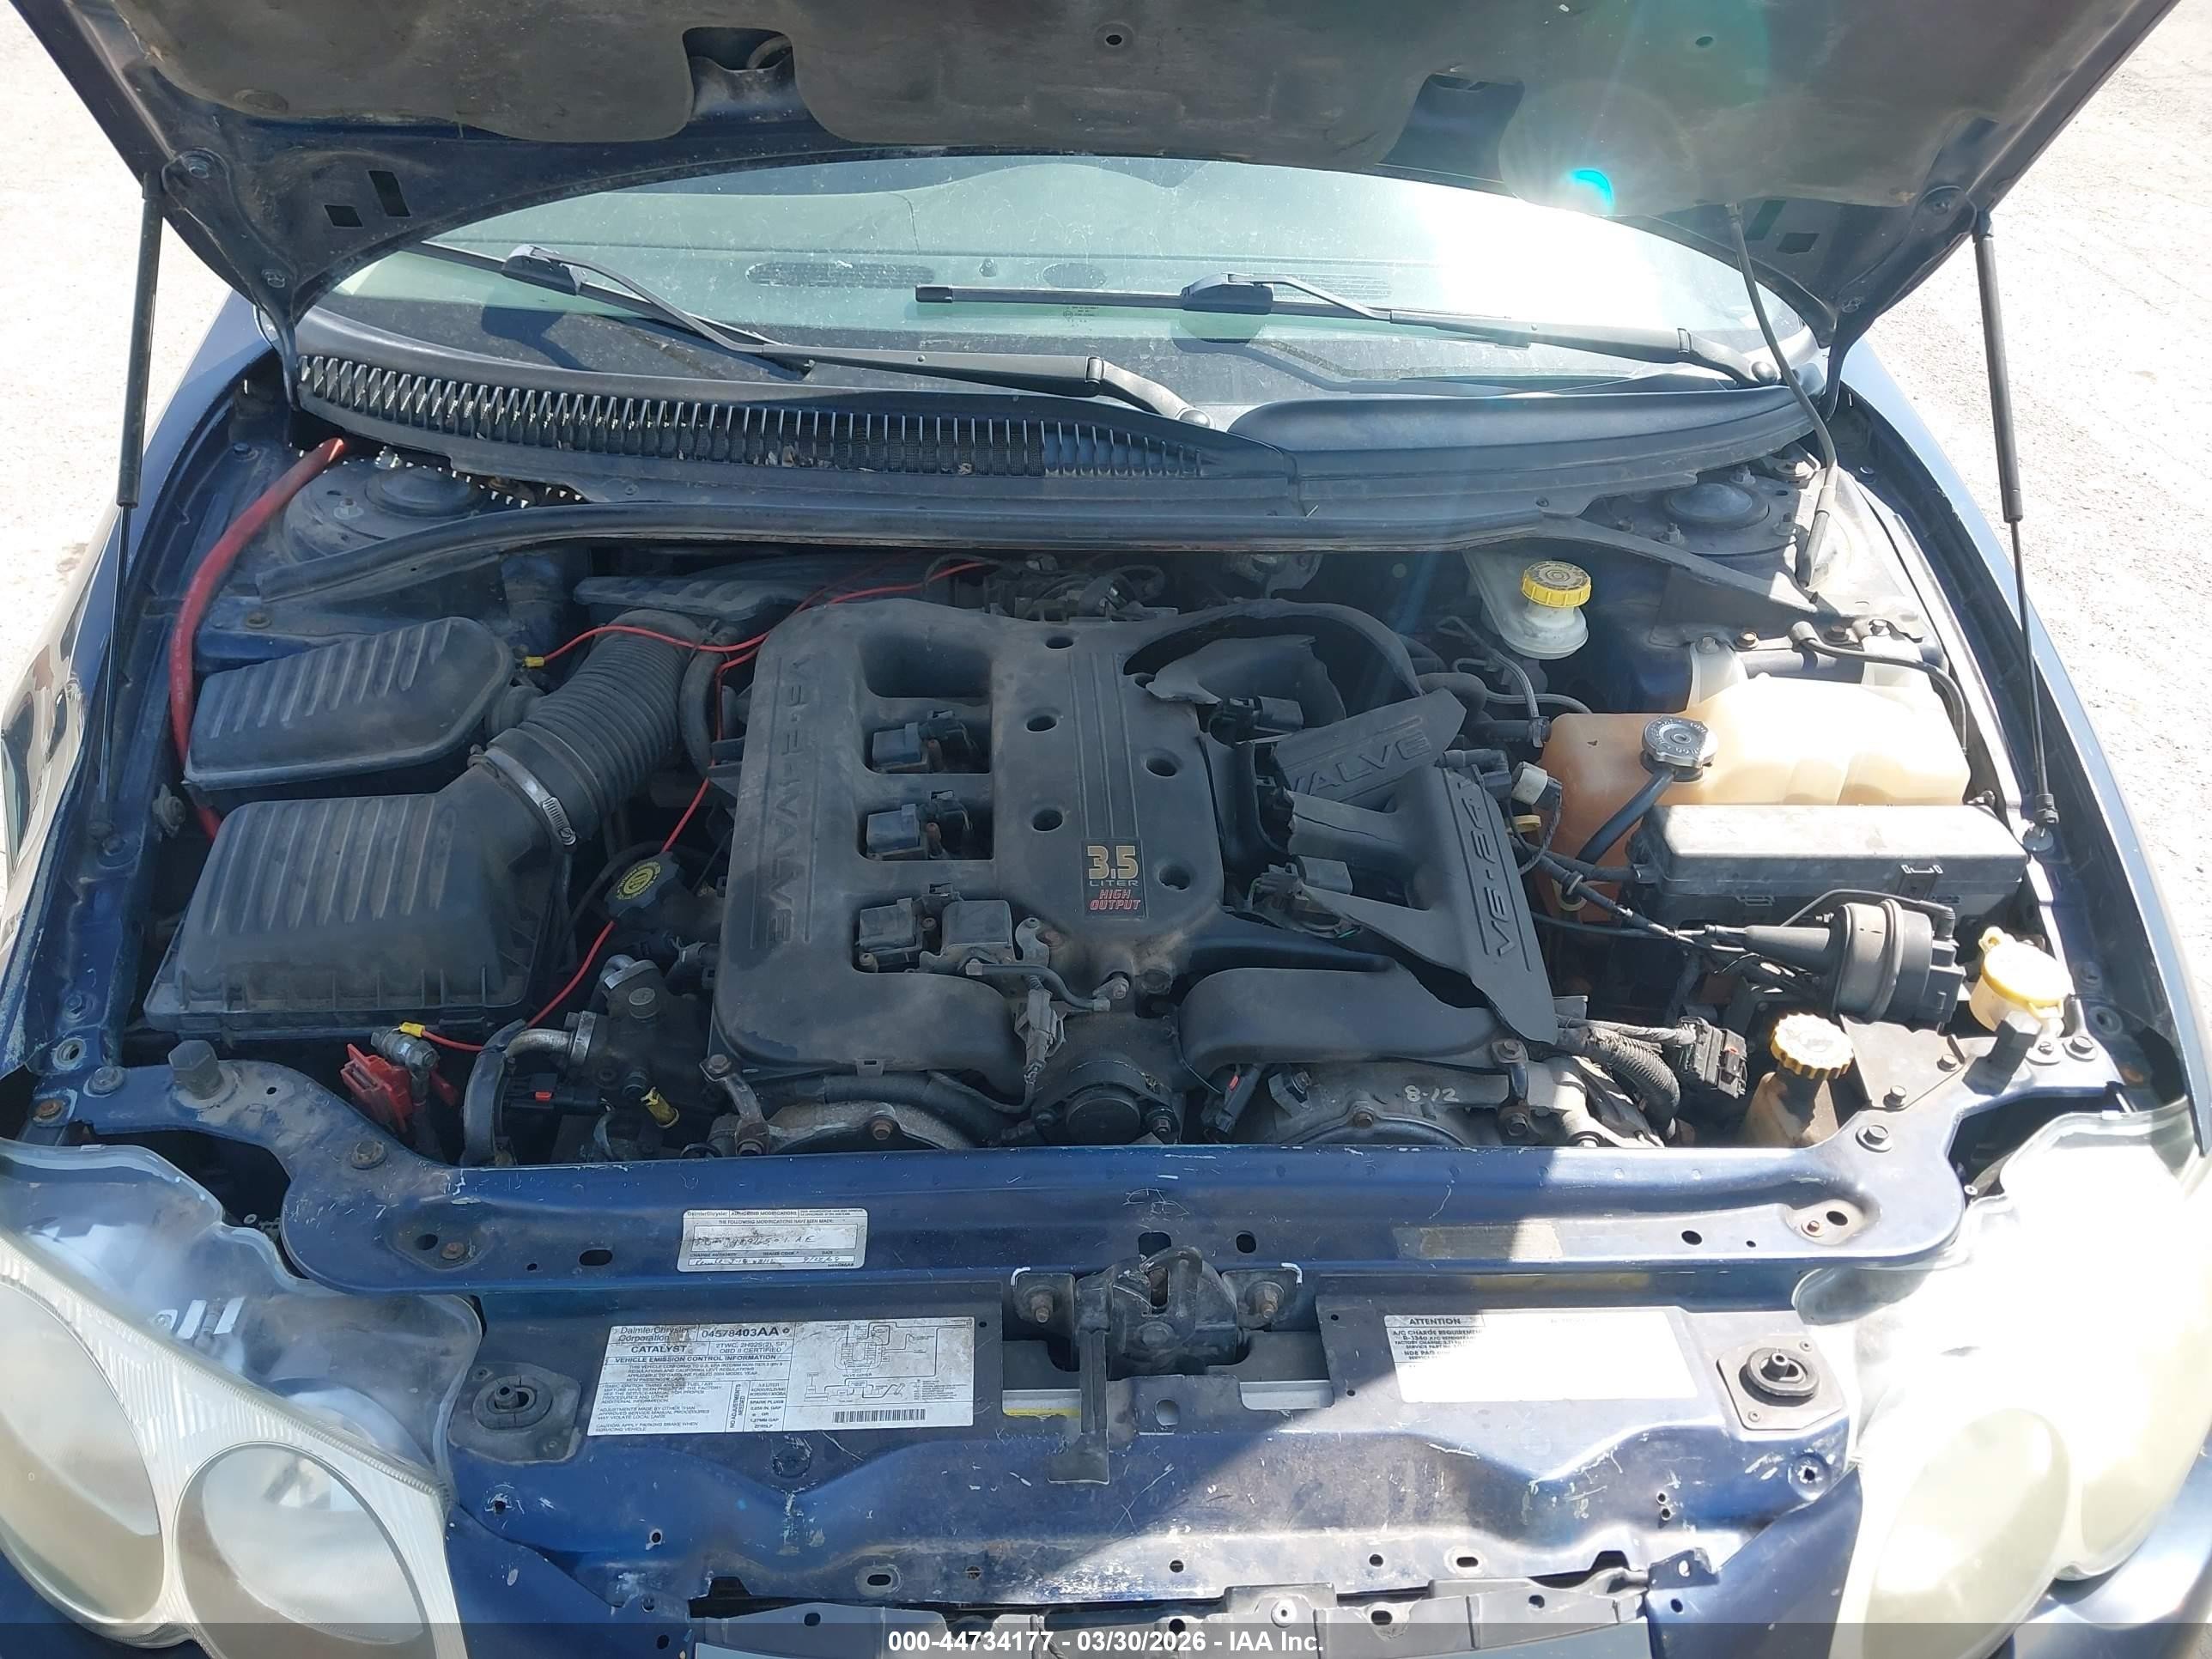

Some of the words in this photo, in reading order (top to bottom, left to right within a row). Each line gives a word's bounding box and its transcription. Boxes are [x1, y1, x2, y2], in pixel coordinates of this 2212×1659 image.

[1087, 845, 1139, 880] 3.5
[1099, 889, 1132, 900] HIGH
[1090, 899, 1141, 910] OUTPUT
[1405, 1085, 1460, 1103] 8-12
[618, 1334, 670, 1342] Corporation
[702, 1327, 779, 1338] 04578403AA
[731, 1383, 741, 1420] ADJUSTMENTS
